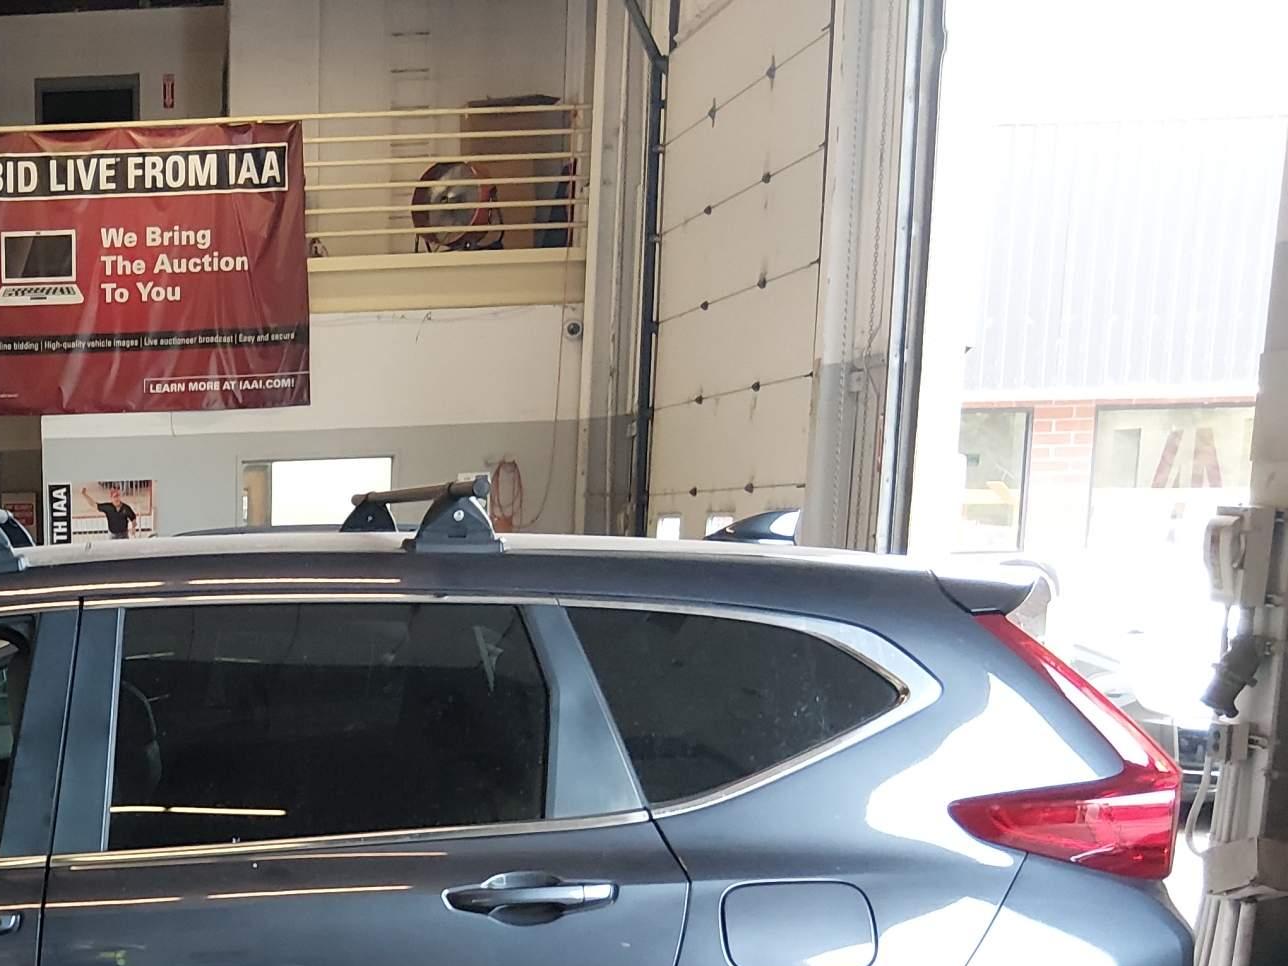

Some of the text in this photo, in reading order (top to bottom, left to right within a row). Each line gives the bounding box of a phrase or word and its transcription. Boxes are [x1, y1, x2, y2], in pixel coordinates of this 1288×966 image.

[49, 158, 116, 192] LIVE
[127, 153, 217, 189] FROM
[228, 151, 281, 185] IAA
[101, 227, 211, 249] We Bring
[101, 252, 249, 276] The Auction
[101, 282, 181, 303] To You
[13, 341, 39, 352] bidding
[44, 340, 85, 352] High-quality
[86, 339, 112, 349] vehicle
[113, 338, 139, 349] images
[144, 336, 158, 346] Live
[159, 335, 197, 346] auctioneer
[198, 334, 234, 344] broadcast
[238, 333, 255, 344] Easy
[256, 332, 269, 342] and
[270, 332, 295, 341] secure
[149, 378, 295, 394] LEARN MORE AT IAAI.COM!
[52, 488, 68, 517] IAA
